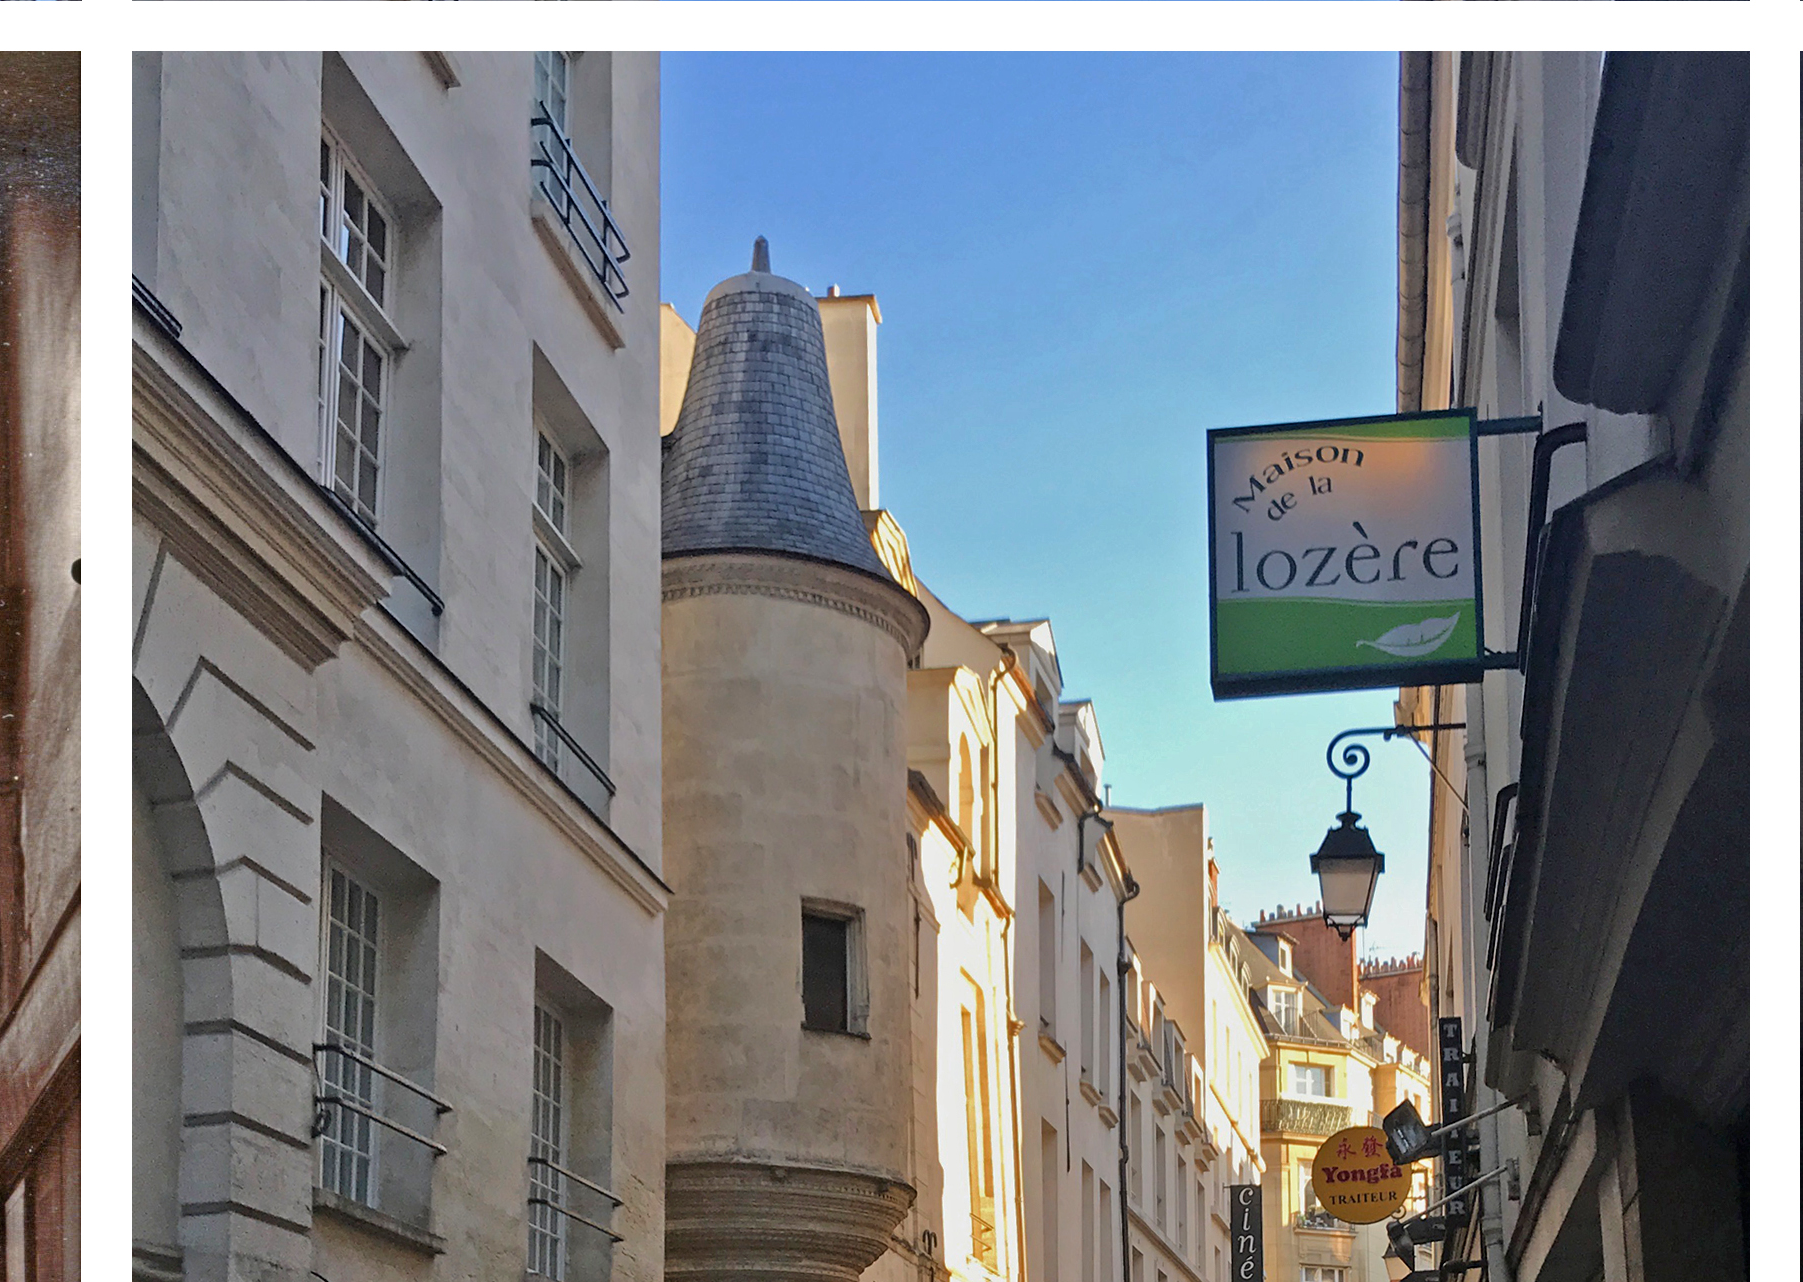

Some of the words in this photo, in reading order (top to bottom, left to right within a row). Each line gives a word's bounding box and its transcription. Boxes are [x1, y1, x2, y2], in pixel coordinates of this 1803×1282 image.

[1232, 445, 1365, 513] Maison
[1266, 491, 1298, 522] de
[1308, 475, 1332, 496] la
[1231, 521, 1459, 594] lozère
[1321, 1162, 1404, 1185] Yongfa
[1328, 1191, 1398, 1206] TRAITEUR
